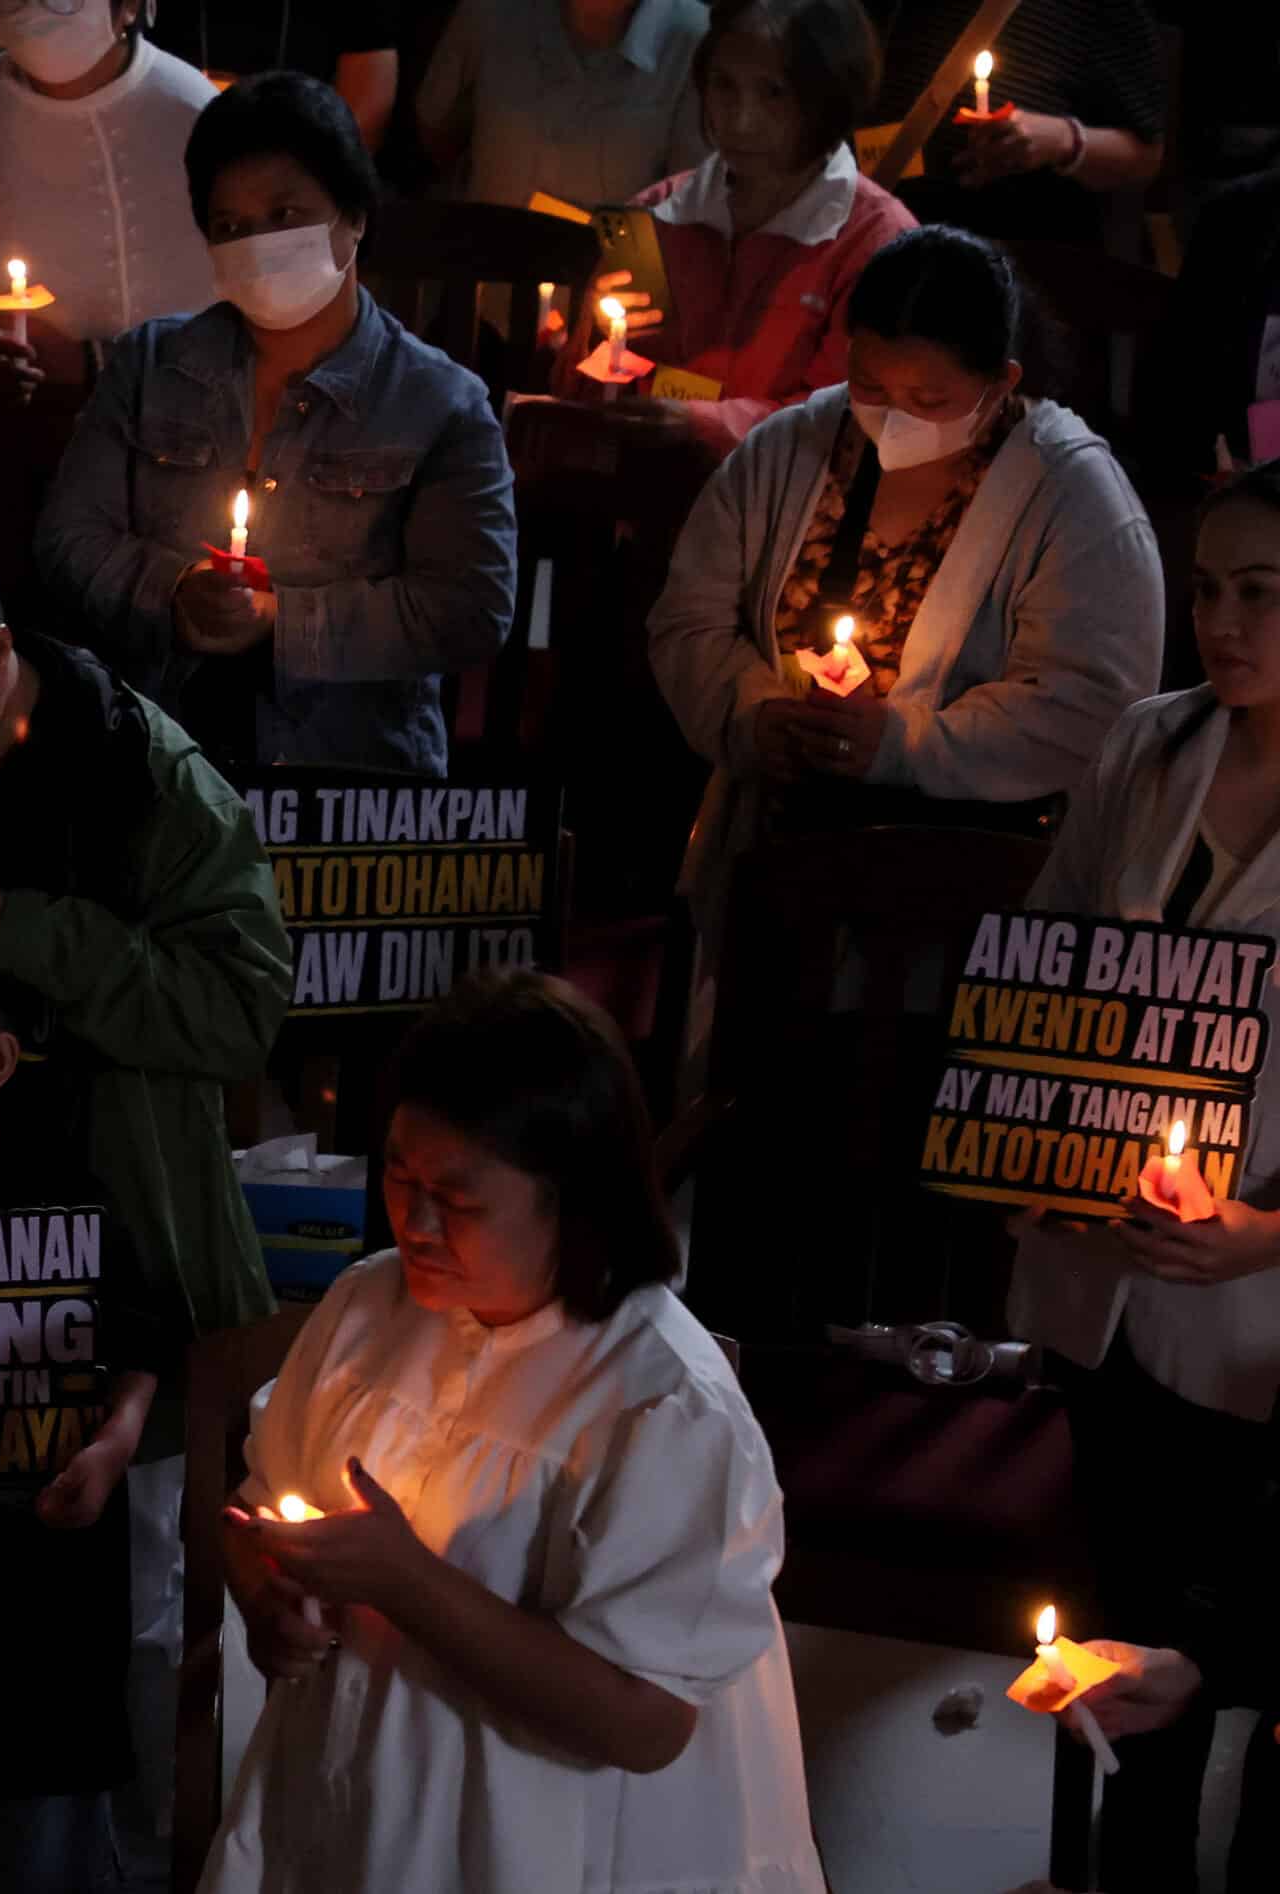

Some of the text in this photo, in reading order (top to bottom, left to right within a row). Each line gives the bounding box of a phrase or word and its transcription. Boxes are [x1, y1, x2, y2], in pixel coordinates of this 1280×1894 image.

[315, 787, 528, 843] TINAKPAN
[273, 853, 545, 917] ATOTOHANAN
[292, 929, 369, 1005] AW
[378, 928, 456, 1001] DIN
[962, 912, 1269, 1009] ANG BAWAT
[947, 983, 1262, 1074] KWENTO AT TAO
[933, 1066, 1243, 1148] AY MAY TANGAN NA
[920, 1114, 1236, 1200] KATOTOHAN
